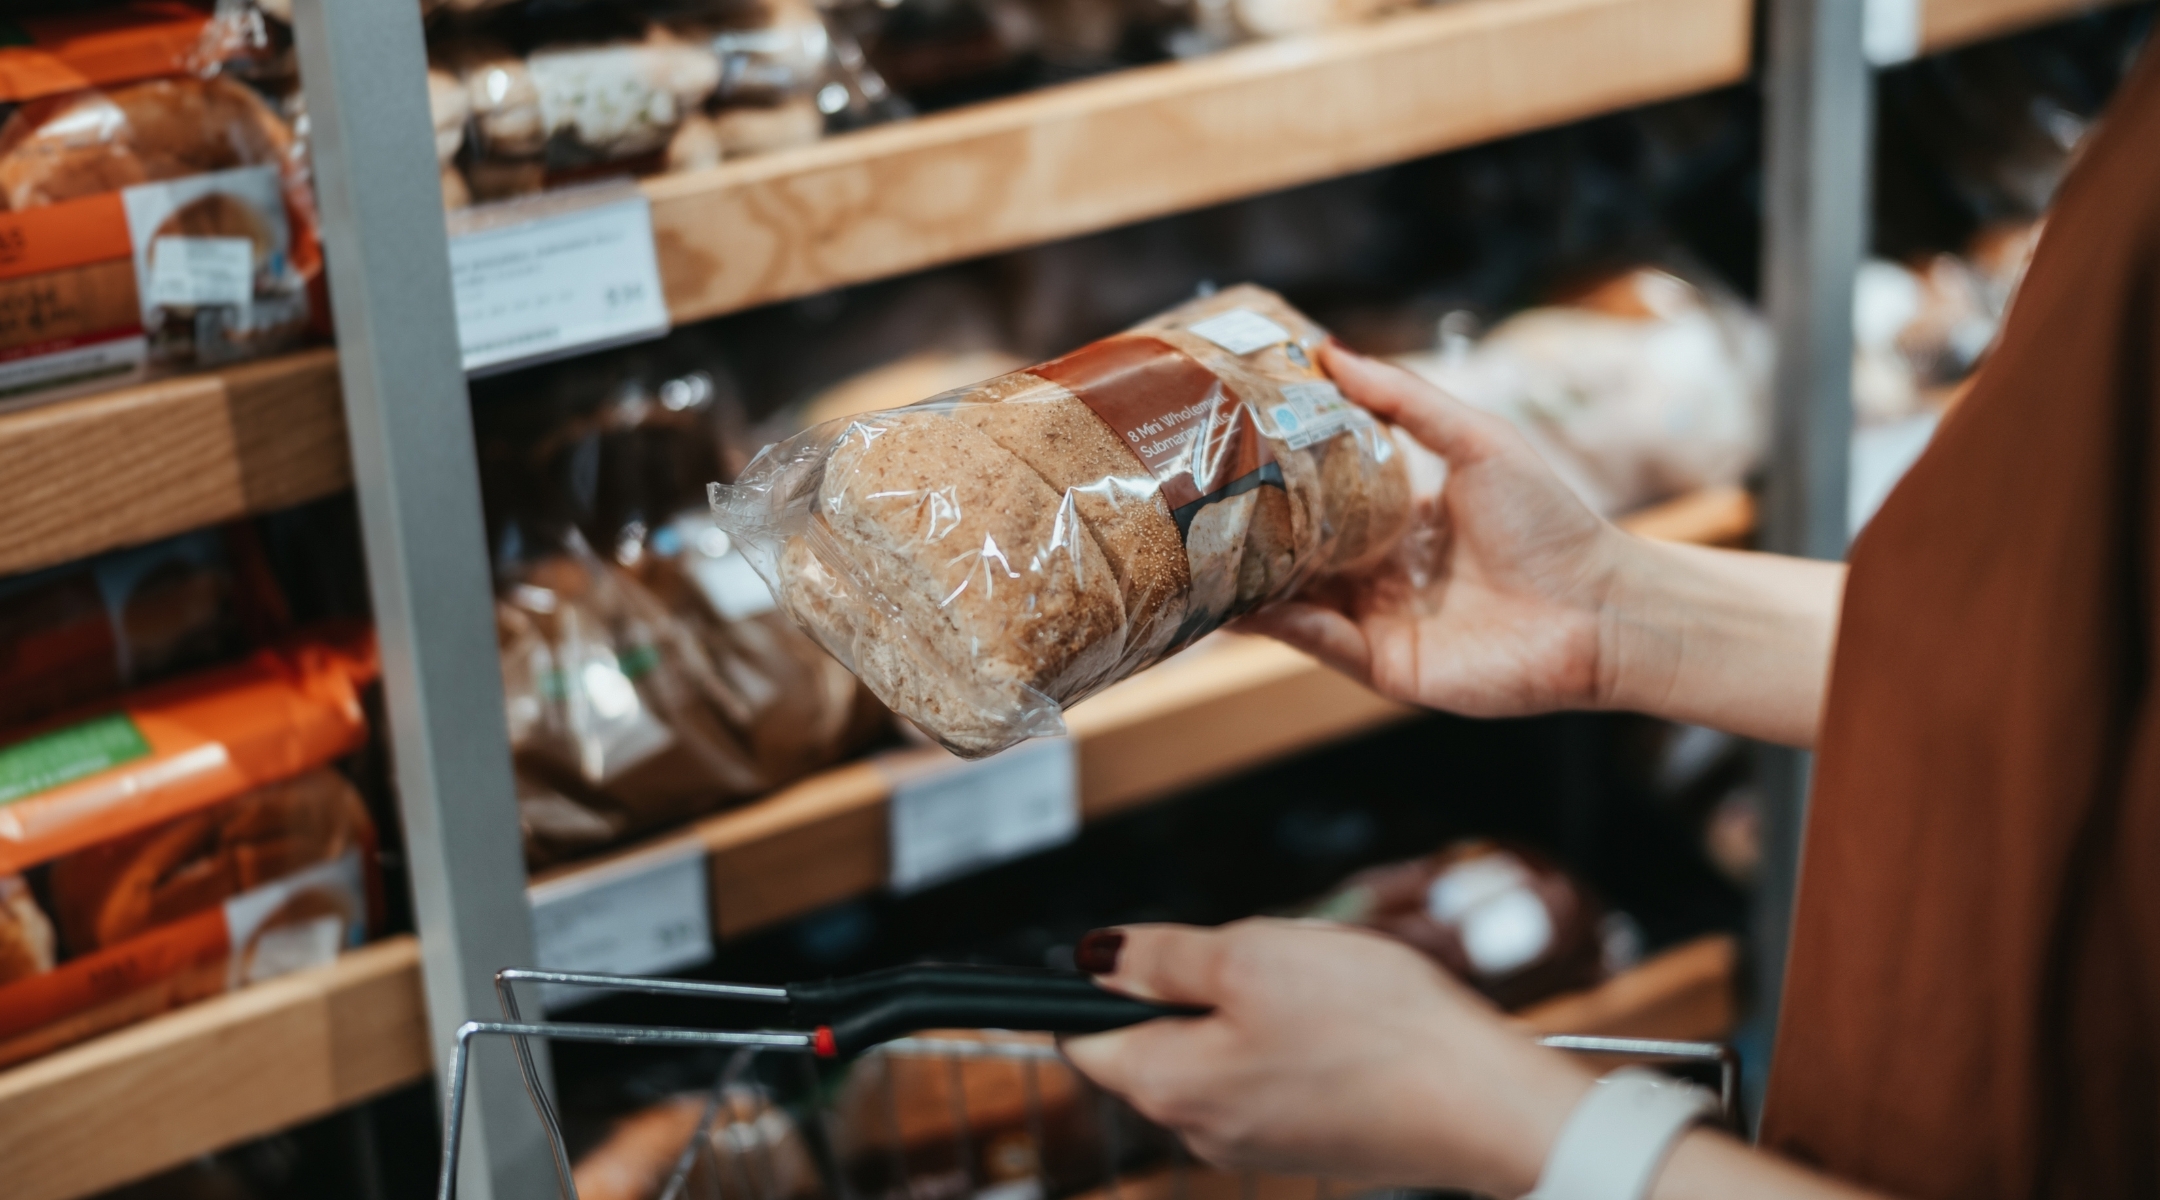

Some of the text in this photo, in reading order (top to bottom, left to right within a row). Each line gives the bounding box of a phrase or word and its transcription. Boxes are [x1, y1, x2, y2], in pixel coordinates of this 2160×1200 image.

[1127, 391, 1230, 443] 8 Mini Wholemeal
[1202, 411, 1232, 433] olls
